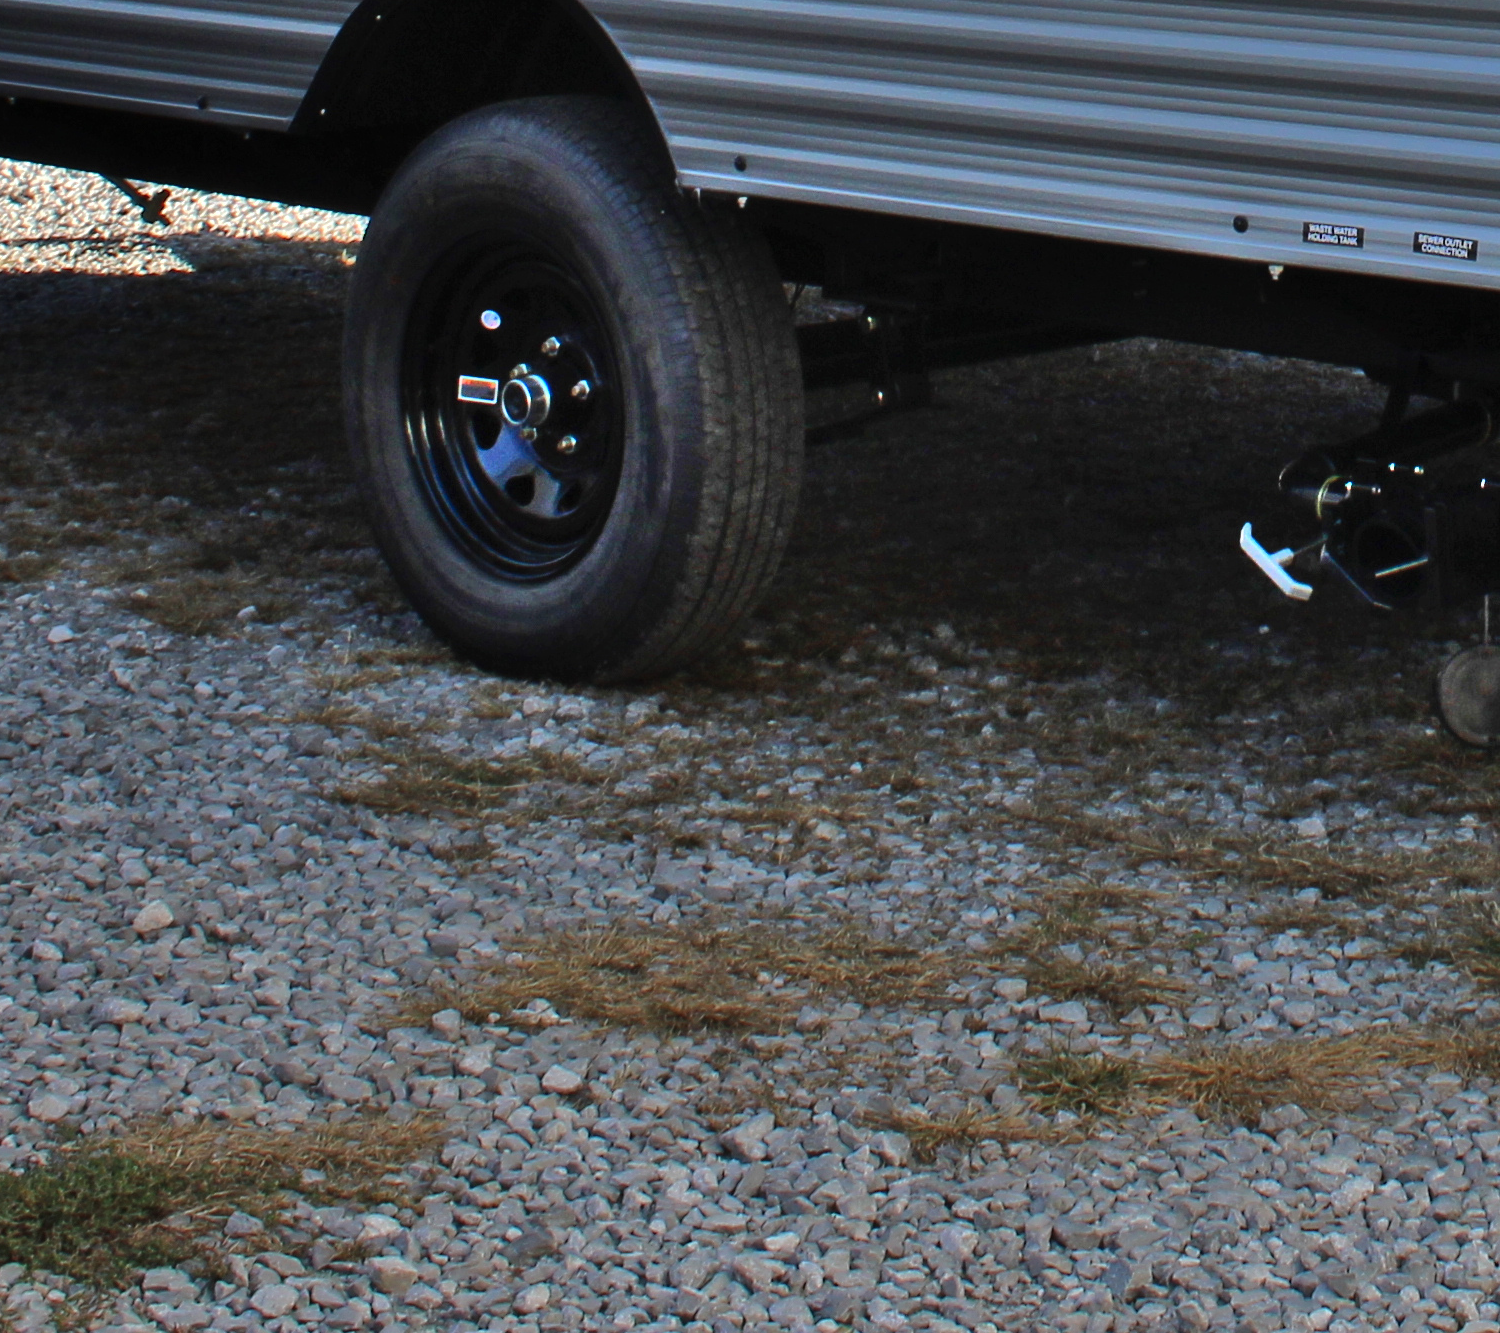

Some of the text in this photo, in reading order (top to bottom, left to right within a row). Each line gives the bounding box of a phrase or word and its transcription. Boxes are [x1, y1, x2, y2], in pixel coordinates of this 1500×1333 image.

[1308, 224, 1358, 237] WASTE WATER
[1307, 233, 1358, 246] HOLDING TANK
[1418, 234, 1473, 250] SEWER OUTLET
[1421, 242, 1469, 259] CONNECTION
